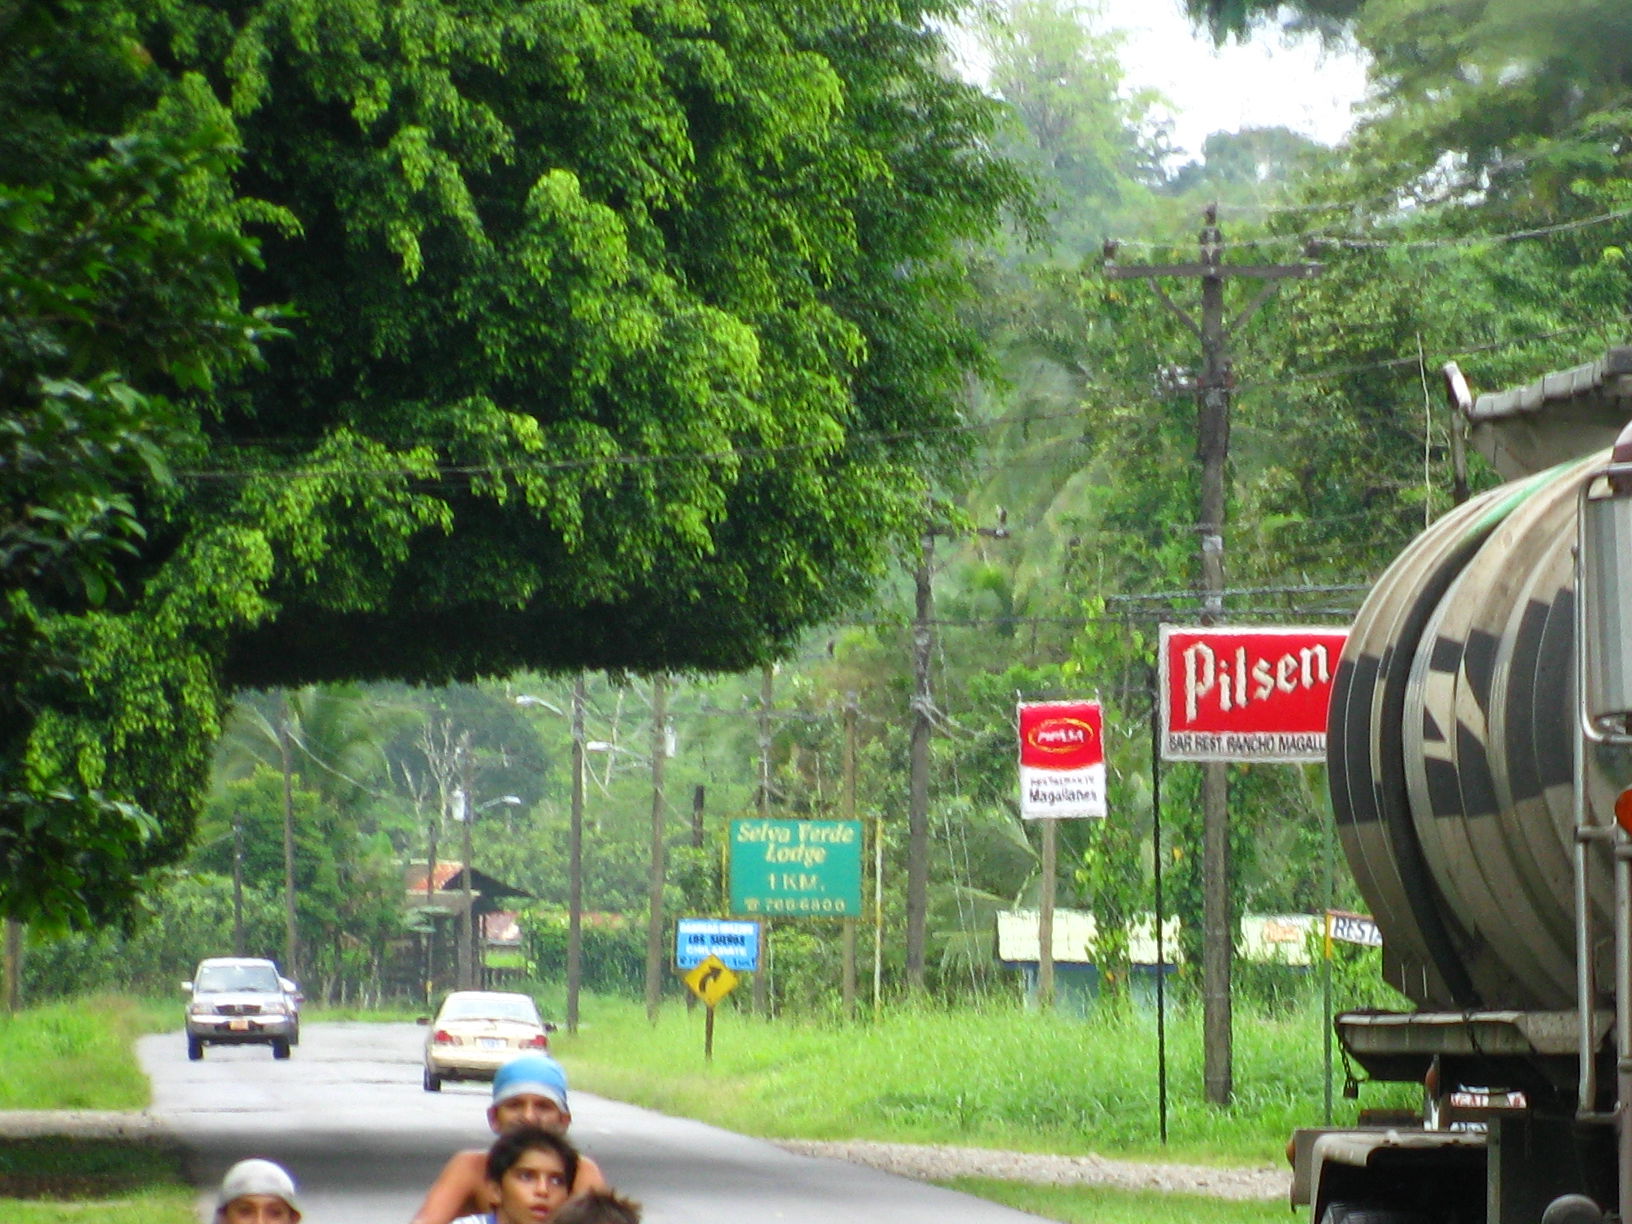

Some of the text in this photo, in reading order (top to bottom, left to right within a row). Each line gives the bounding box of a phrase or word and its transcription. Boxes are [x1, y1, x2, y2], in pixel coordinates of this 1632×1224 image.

[1183, 641, 1330, 724] Pilsen
[1227, 734, 1275, 751] RANCHO
[737, 822, 854, 844] Selva Verde
[765, 842, 827, 868] Lodge
[769, 873, 776, 890] 1
